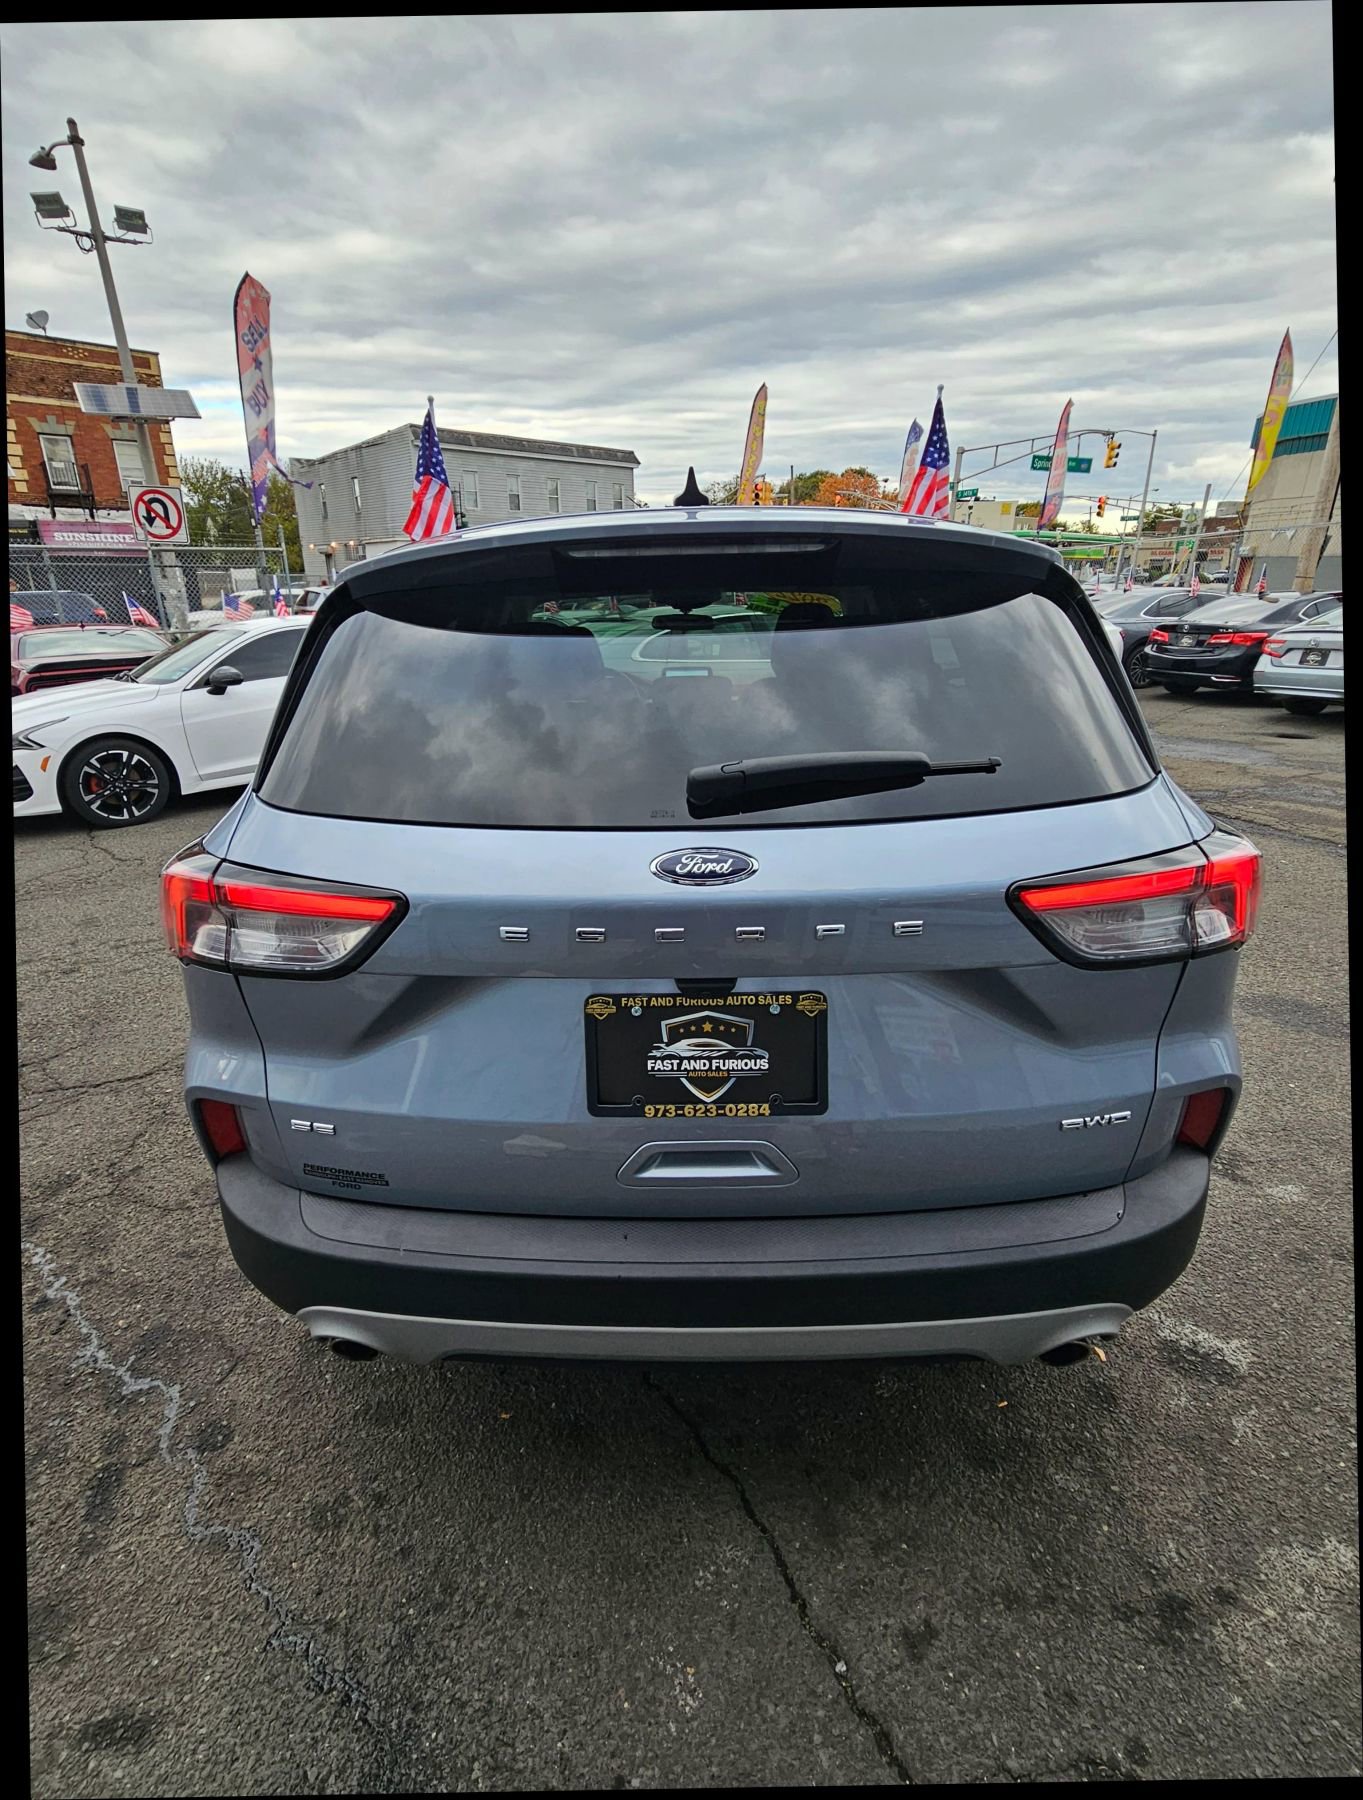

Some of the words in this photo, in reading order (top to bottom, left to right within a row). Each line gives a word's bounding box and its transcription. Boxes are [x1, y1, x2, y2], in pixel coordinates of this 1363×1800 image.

[247, 379, 270, 417] BUY
[53, 532, 135, 543] SUNSHINE
[675, 853, 734, 874] Ford
[499, 920, 924, 943] ESCAPE
[621, 997, 648, 1007] FAST
[650, 997, 673, 1007] AND
[676, 997, 724, 1006] FURIOUS
[726, 995, 756, 1006] AUTO
[758, 994, 792, 1005] SALES
[647, 1059, 680, 1071] FAST
[681, 1059, 709, 1071] AND
[711, 1059, 769, 1070] FURIOUS
[644, 1103, 771, 1117] 973-623-0284
[290, 1119, 336, 1136] SE
[1061, 1110, 1132, 1129] AWD
[303, 1163, 386, 1180] PERFORMANCE
[332, 1180, 362, 1190] FORD
